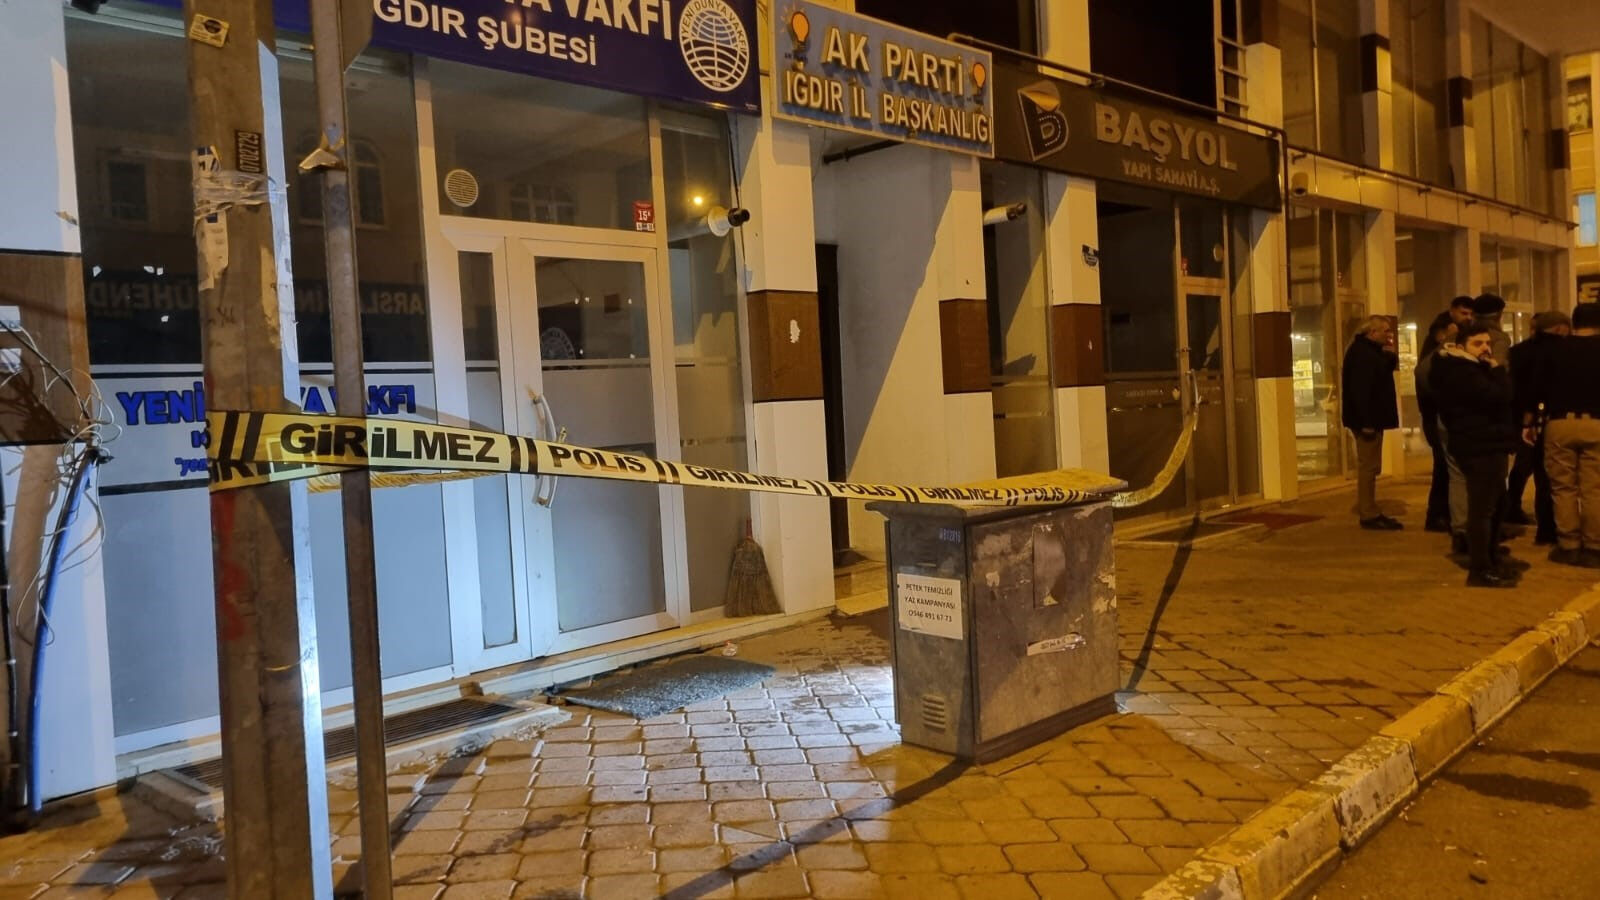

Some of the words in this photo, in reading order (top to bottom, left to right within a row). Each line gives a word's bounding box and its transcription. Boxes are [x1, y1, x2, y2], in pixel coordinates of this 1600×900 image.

[477, 16, 597, 66] ŞUBESİ
[823, 27, 870, 73] AK
[883, 42, 964, 96] PARTİ
[851, 79, 872, 119] İL
[882, 93, 993, 144] BAŞKANLIĞI
[1095, 102, 1237, 171] BAŞYOL
[1122, 159, 1152, 180] YAPI
